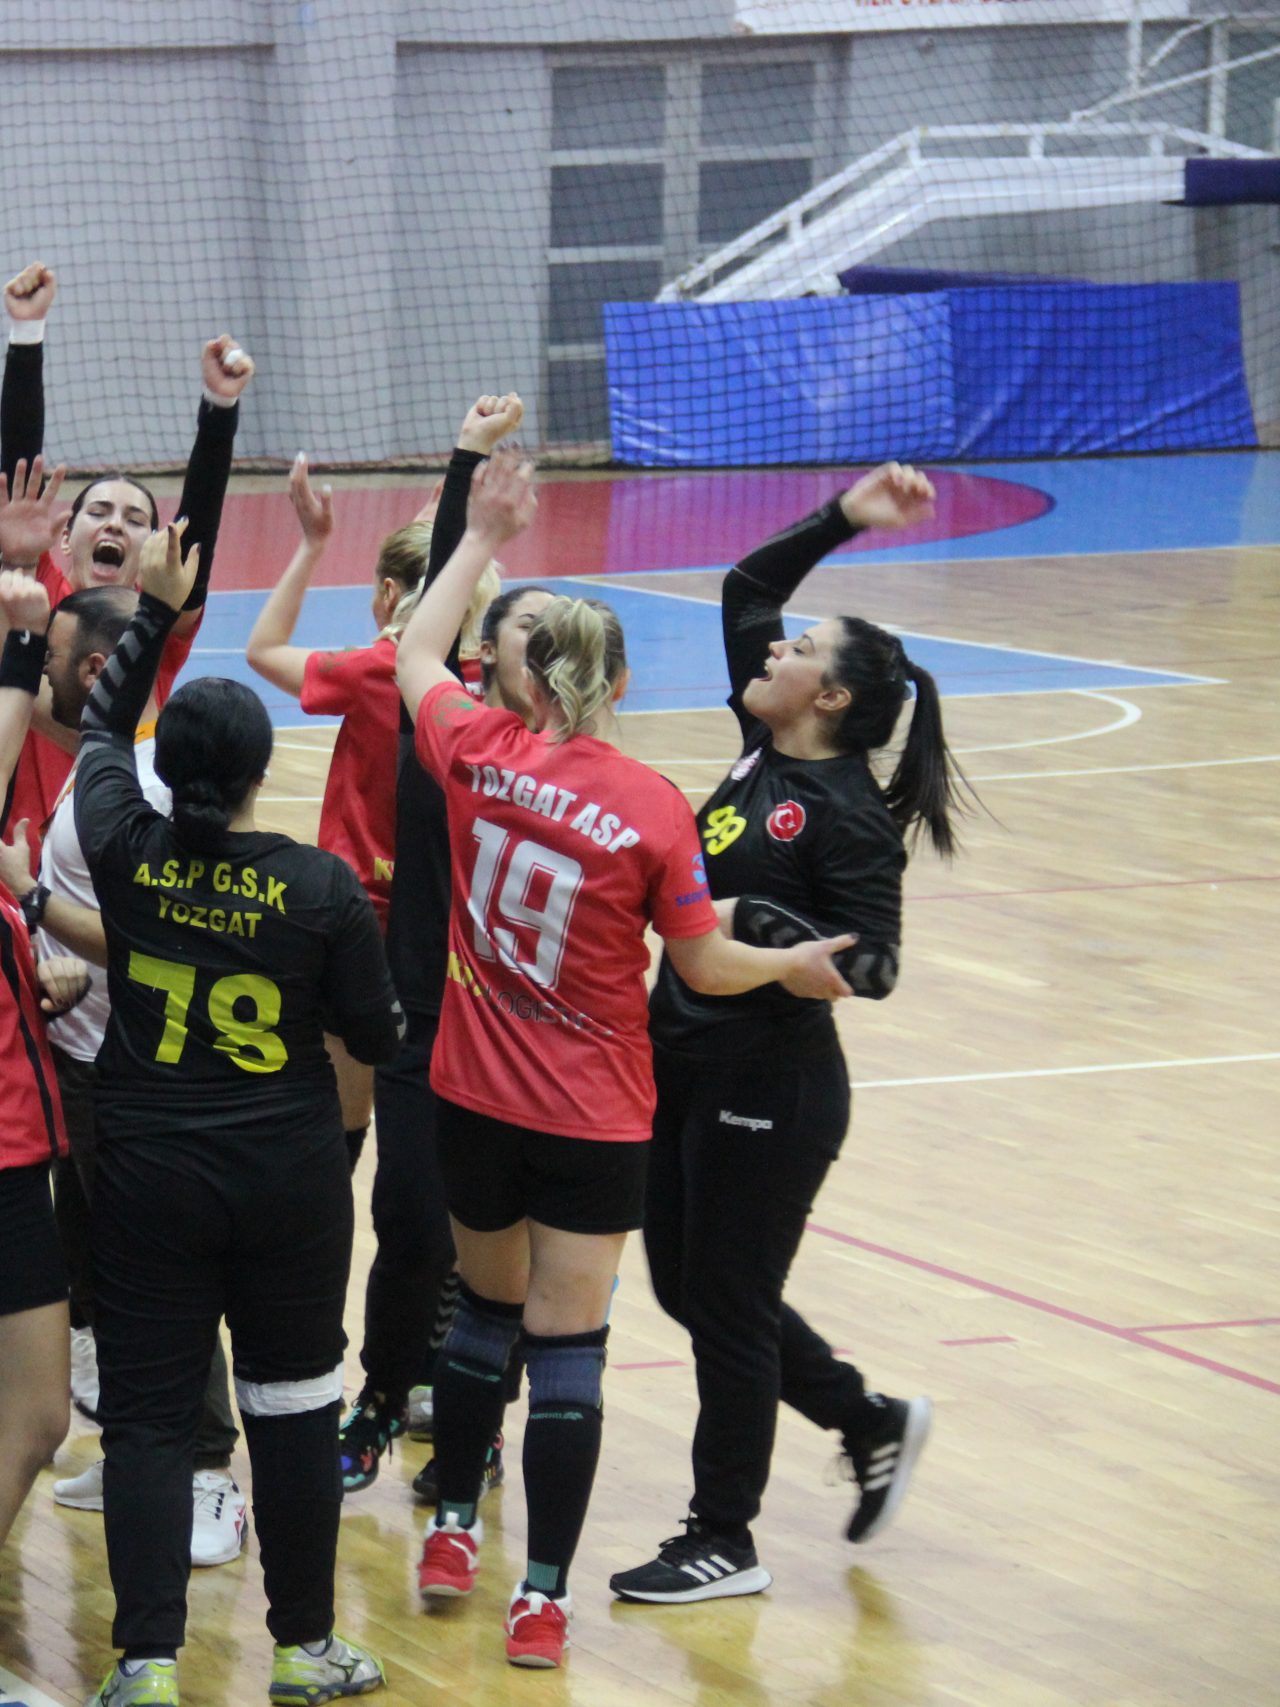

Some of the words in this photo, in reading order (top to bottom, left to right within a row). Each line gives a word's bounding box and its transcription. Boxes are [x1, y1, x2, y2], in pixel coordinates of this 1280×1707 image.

[465, 764, 577, 822] YOZGAT
[569, 803, 640, 854] ASP
[133, 859, 205, 889] A.S.P
[213, 862, 287, 915] G.S.K
[158, 895, 262, 938] YOZGAT
[467, 817, 585, 991] 19
[128, 950, 289, 1074] 78
[719, 1109, 773, 1132] Kempa
